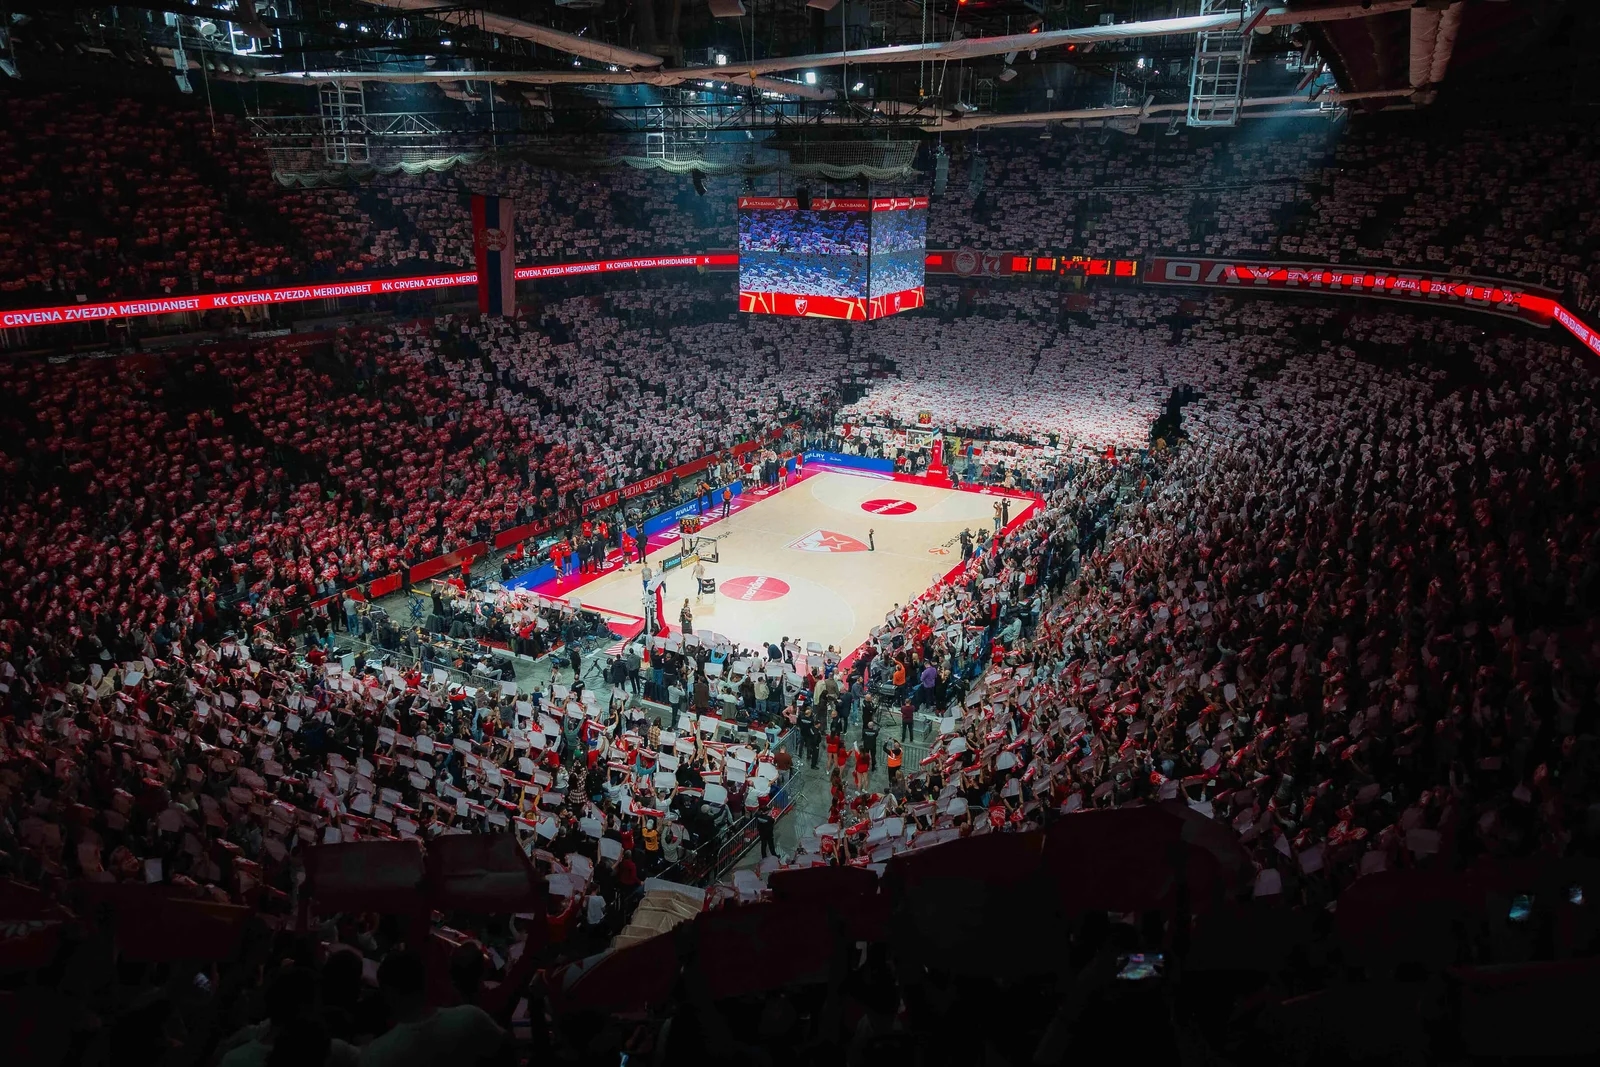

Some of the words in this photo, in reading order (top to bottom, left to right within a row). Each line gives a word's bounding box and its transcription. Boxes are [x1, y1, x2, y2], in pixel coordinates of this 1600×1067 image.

[517, 270, 542, 278] CRVENA
[542, 267, 566, 275] ZVEZDA
[565, 263, 601, 273] MERIDIANBET
[657, 257, 697, 266] MERIDIANBET
[382, 283, 393, 291] KK
[394, 279, 425, 290] CRVENA
[426, 277, 455, 286] ZVEZDA
[213, 297, 229, 306] KK
[230, 293, 272, 305] CRVENA
[274, 289, 312, 301] ZVEZDA
[313, 283, 372, 297] MERIDIANBET
[3, 311, 61, 326] CRVENA
[64, 306, 116, 320] ZVEZDA
[119, 298, 200, 315] MERIDIANBET
[741, 576, 768, 601] meridian
